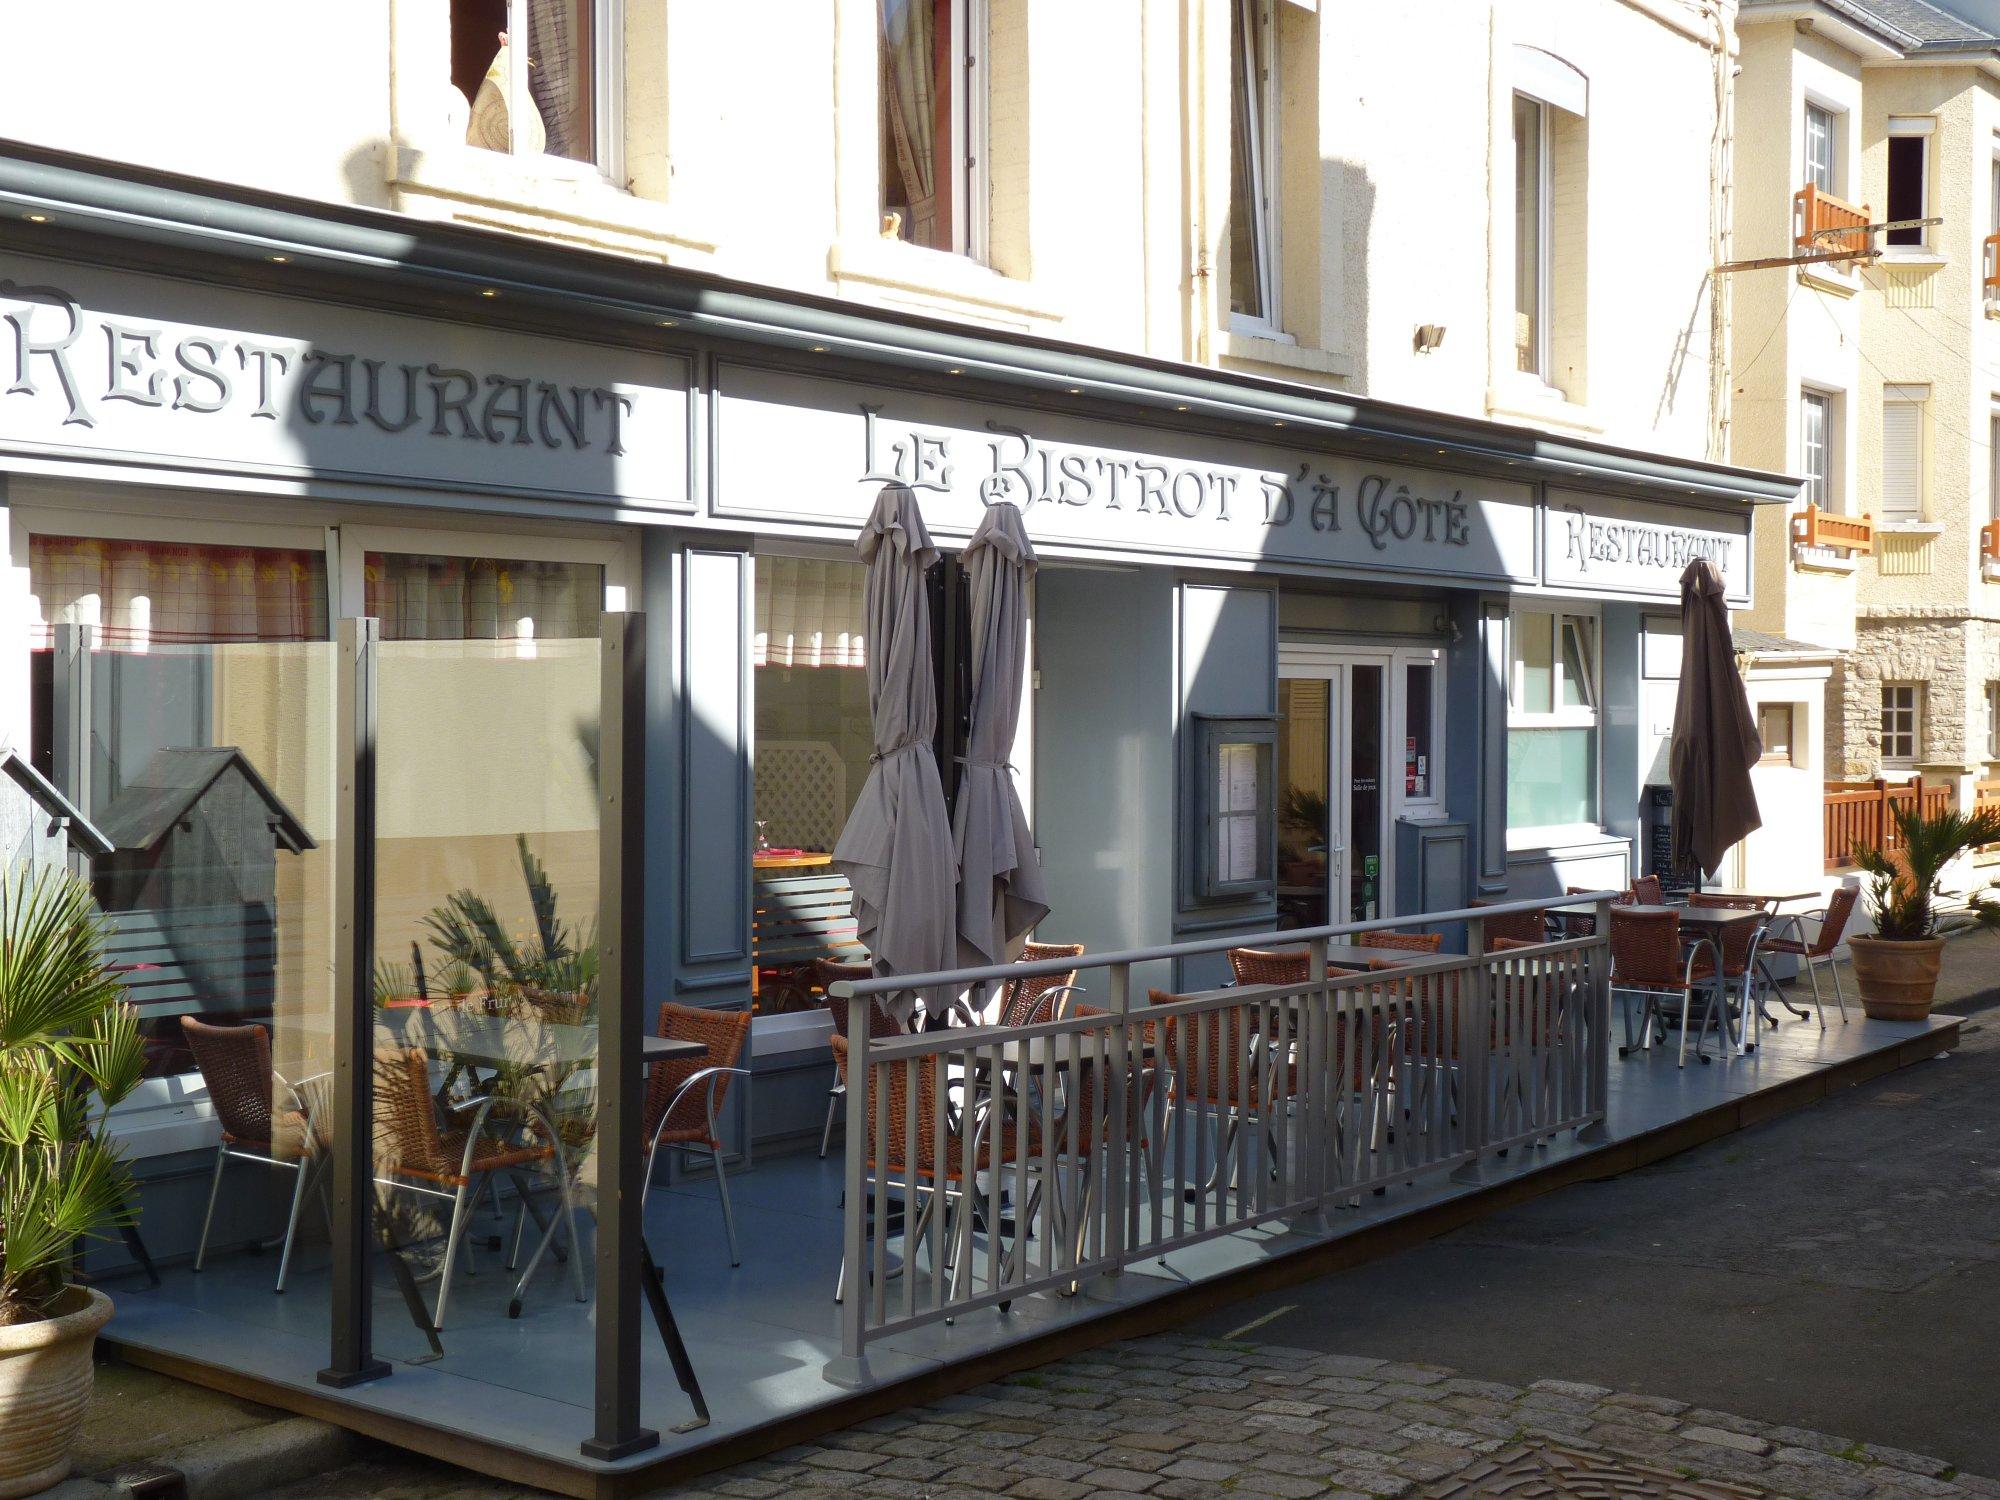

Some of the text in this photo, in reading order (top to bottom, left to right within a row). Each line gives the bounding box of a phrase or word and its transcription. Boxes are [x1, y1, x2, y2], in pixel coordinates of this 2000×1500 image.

[0, 278, 639, 458] RESTAURANT
[858, 402, 1470, 550] LE BISTROT D'À CÔTÉ
[1563, 503, 1733, 573] RESTAURANT
